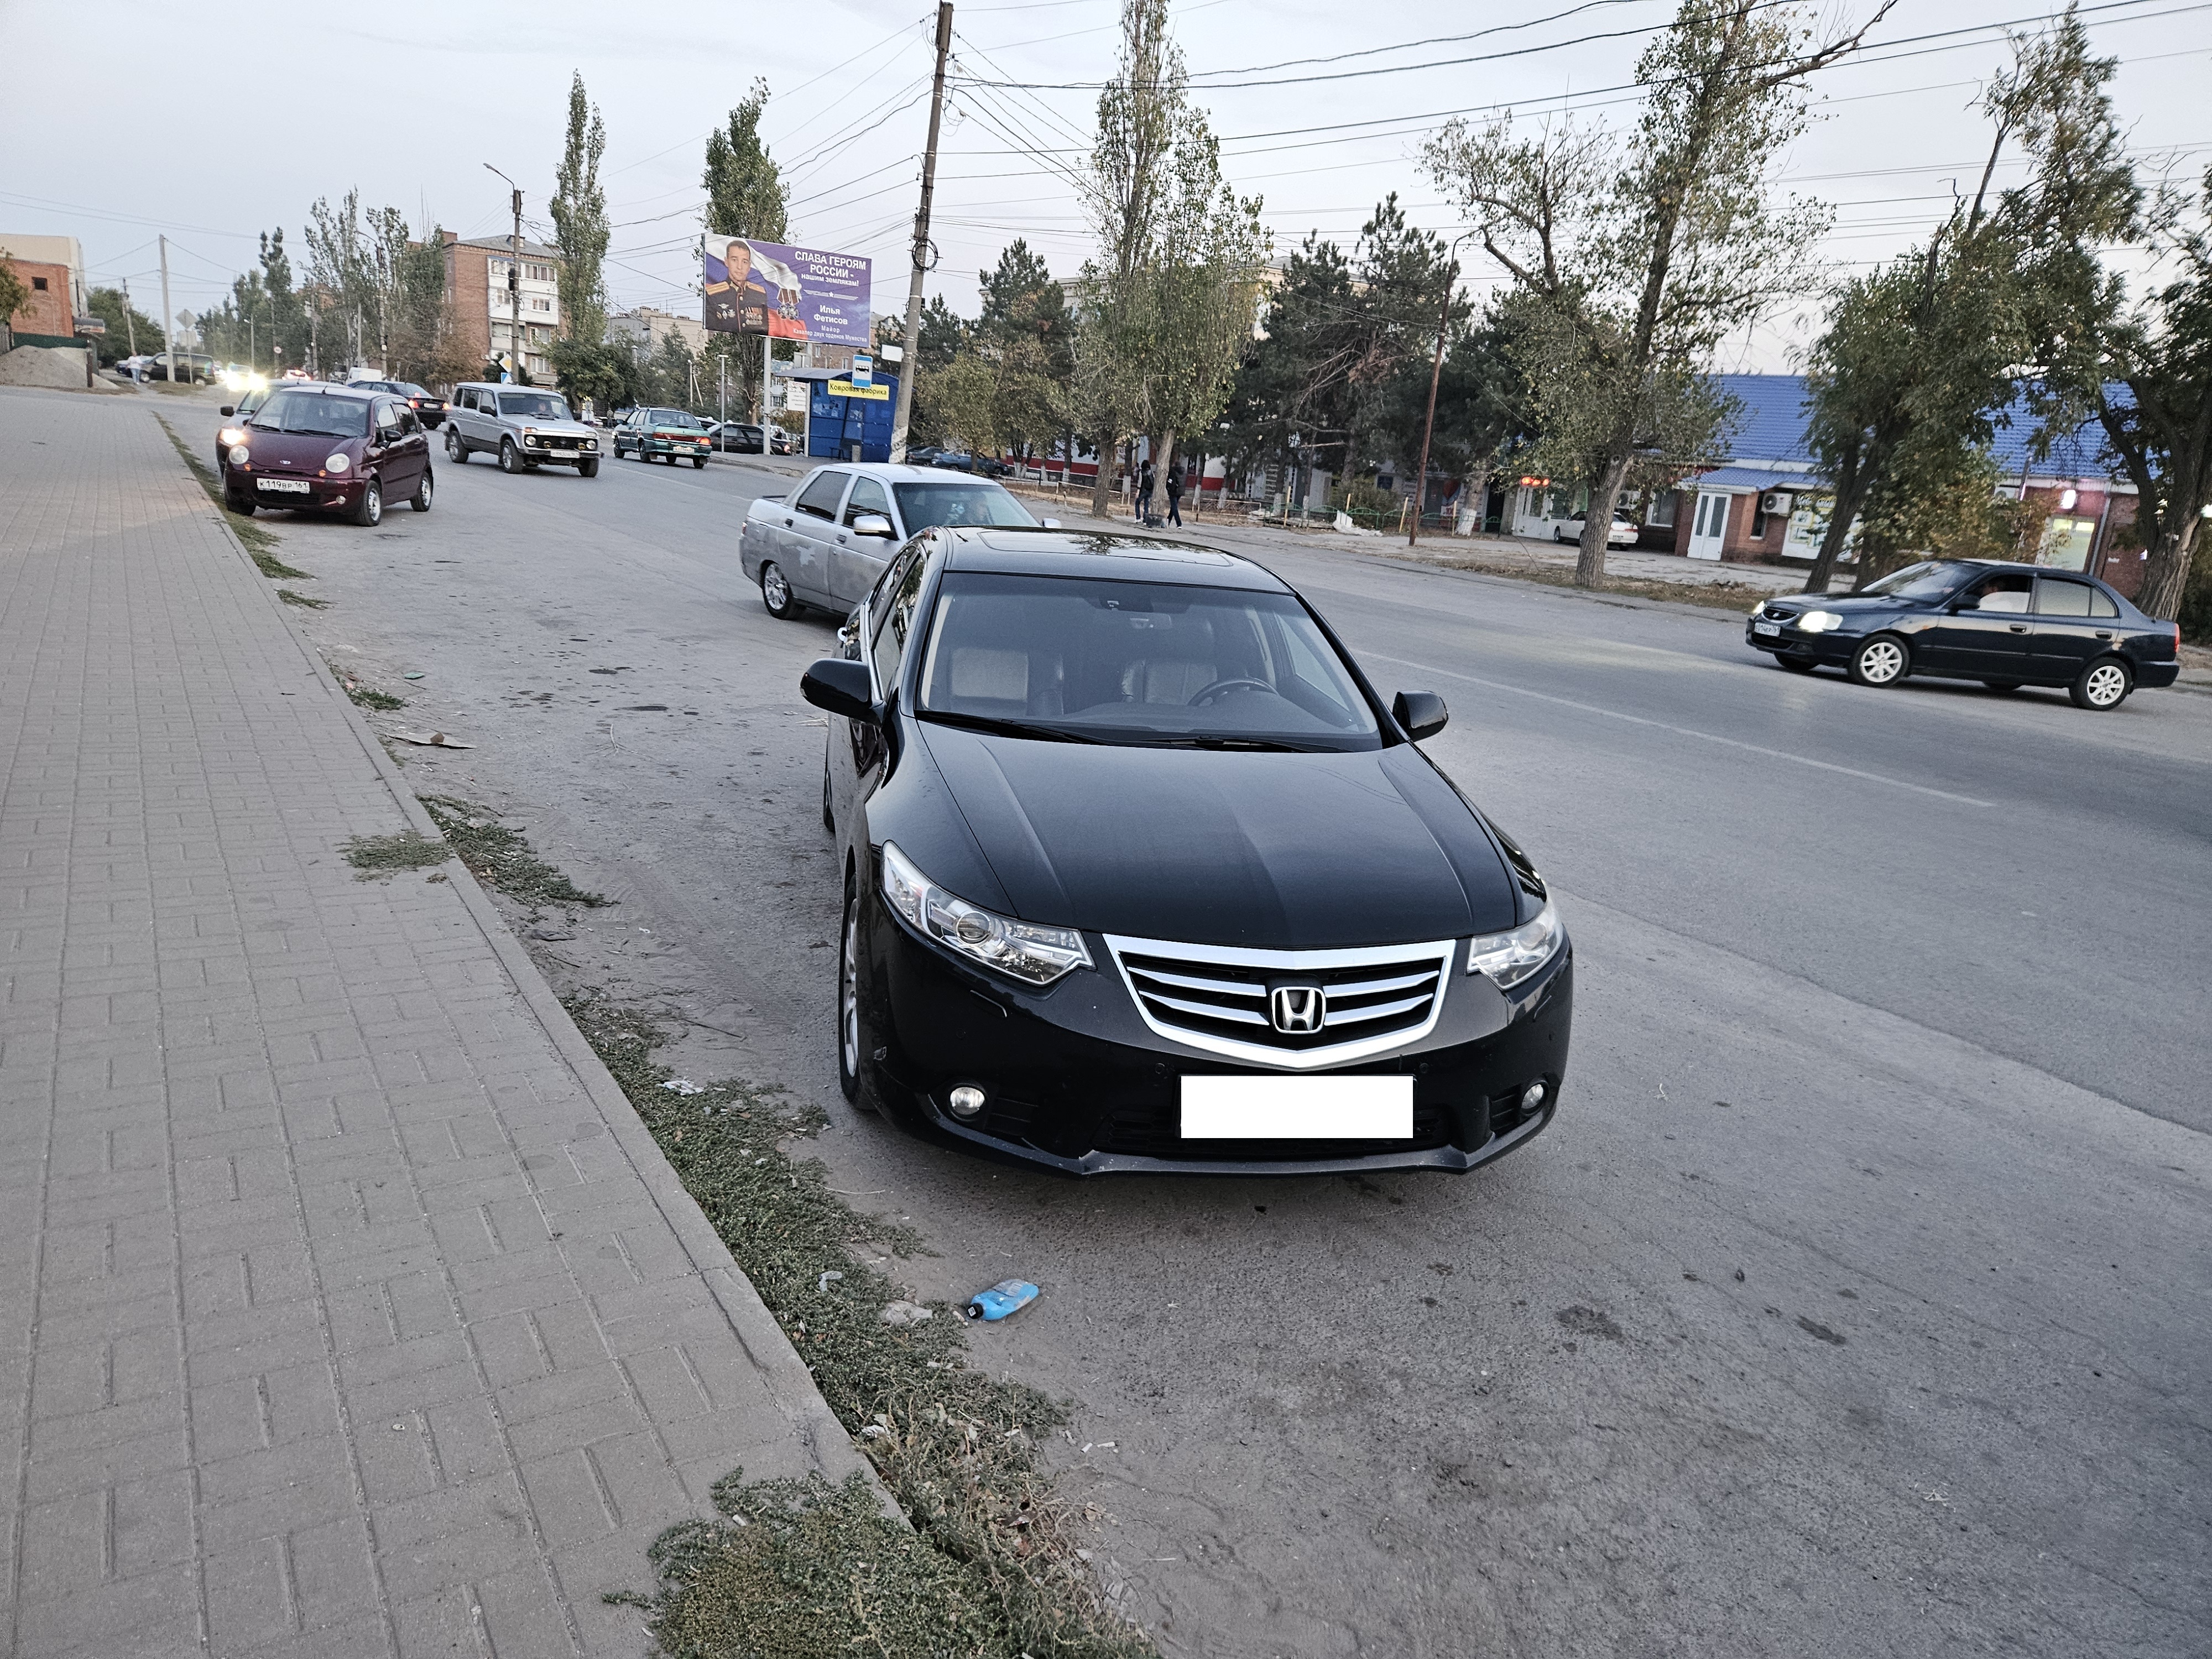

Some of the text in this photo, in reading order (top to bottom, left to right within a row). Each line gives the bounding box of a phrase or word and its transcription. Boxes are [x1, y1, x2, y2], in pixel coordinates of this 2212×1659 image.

[795, 251, 866, 270] СЛАВА ГЕРОЯМ
[810, 264, 848, 278] РОССИИ
[801, 273, 859, 287] нашим землякам!
[820, 304, 841, 315] Илья
[813, 313, 848, 325] Фетисов
[821, 325, 840, 333] Майор
[845, 333, 867, 342] Мужества
[830, 383, 860, 393] Ковровая
